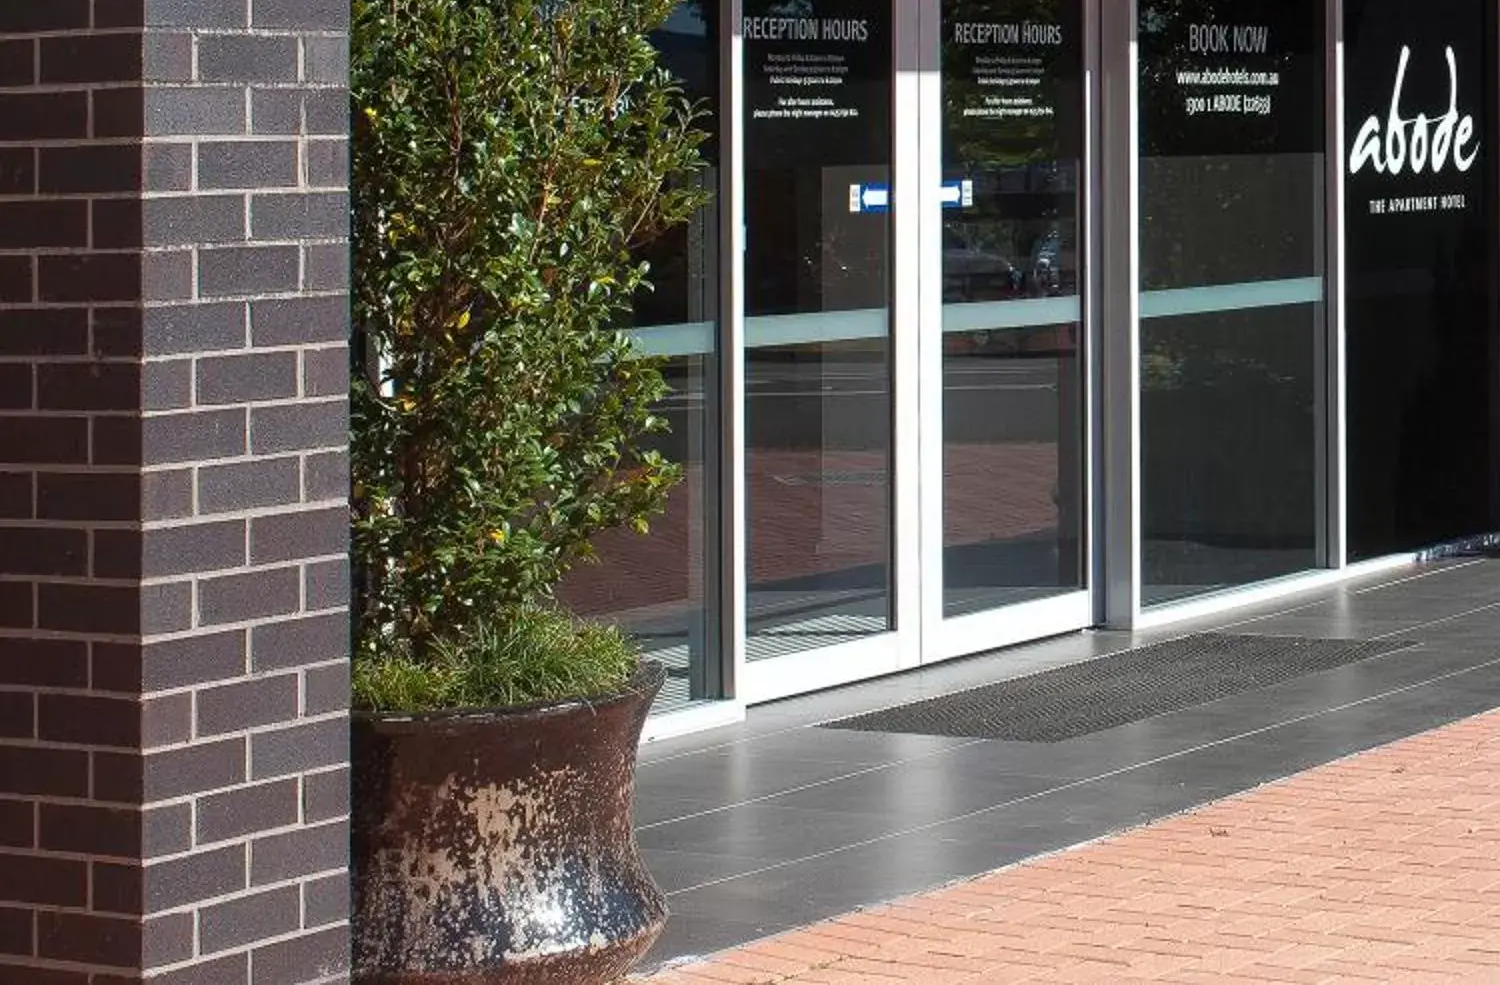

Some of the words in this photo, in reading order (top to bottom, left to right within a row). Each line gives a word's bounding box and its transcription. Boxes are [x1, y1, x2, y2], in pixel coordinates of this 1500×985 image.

[742, 16, 817, 41] RECEPTION
[822, 18, 869, 42] HOURS
[955, 24, 1019, 45] RECEPTION
[1022, 24, 1063, 46] HOURS
[1189, 24, 1229, 52] BOOK
[1233, 26, 1269, 53] NOW
[1213, 94, 1242, 112] ABODE
[1350, 44, 1481, 175] abode
[1369, 199, 1386, 214] THE
[1388, 196, 1438, 213] APARTMENT
[1440, 194, 1466, 210] HOTEL
